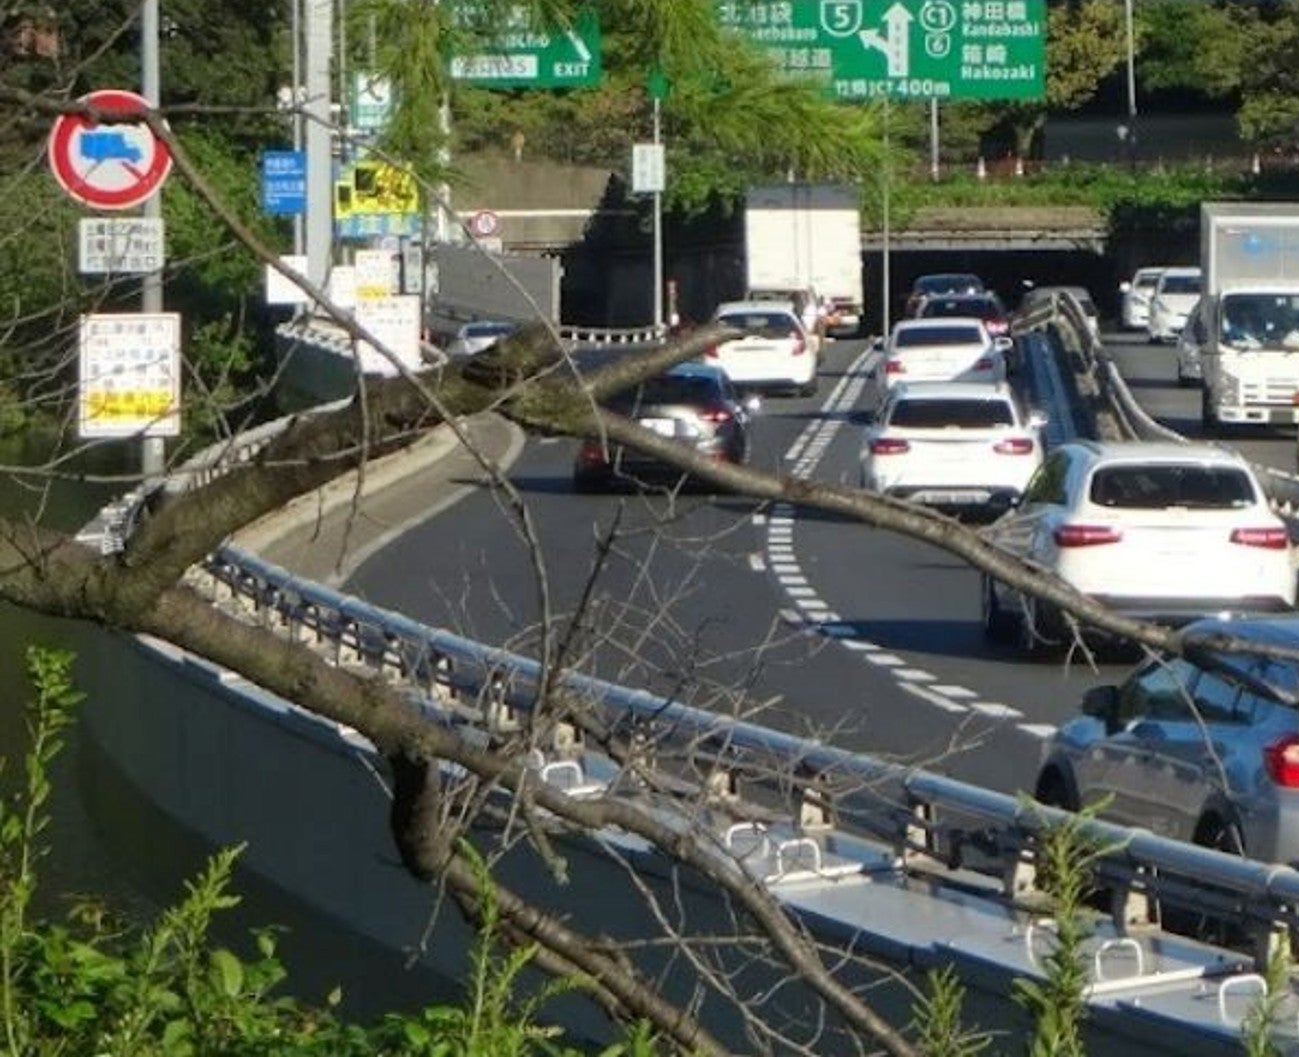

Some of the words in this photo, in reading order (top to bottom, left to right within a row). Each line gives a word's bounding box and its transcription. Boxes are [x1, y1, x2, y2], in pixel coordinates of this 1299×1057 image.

[834, 5, 850, 28] 5
[553, 63, 589, 77] EXIT
[961, 64, 1035, 80] Hakozaki
[897, 79, 951, 95] 400m
